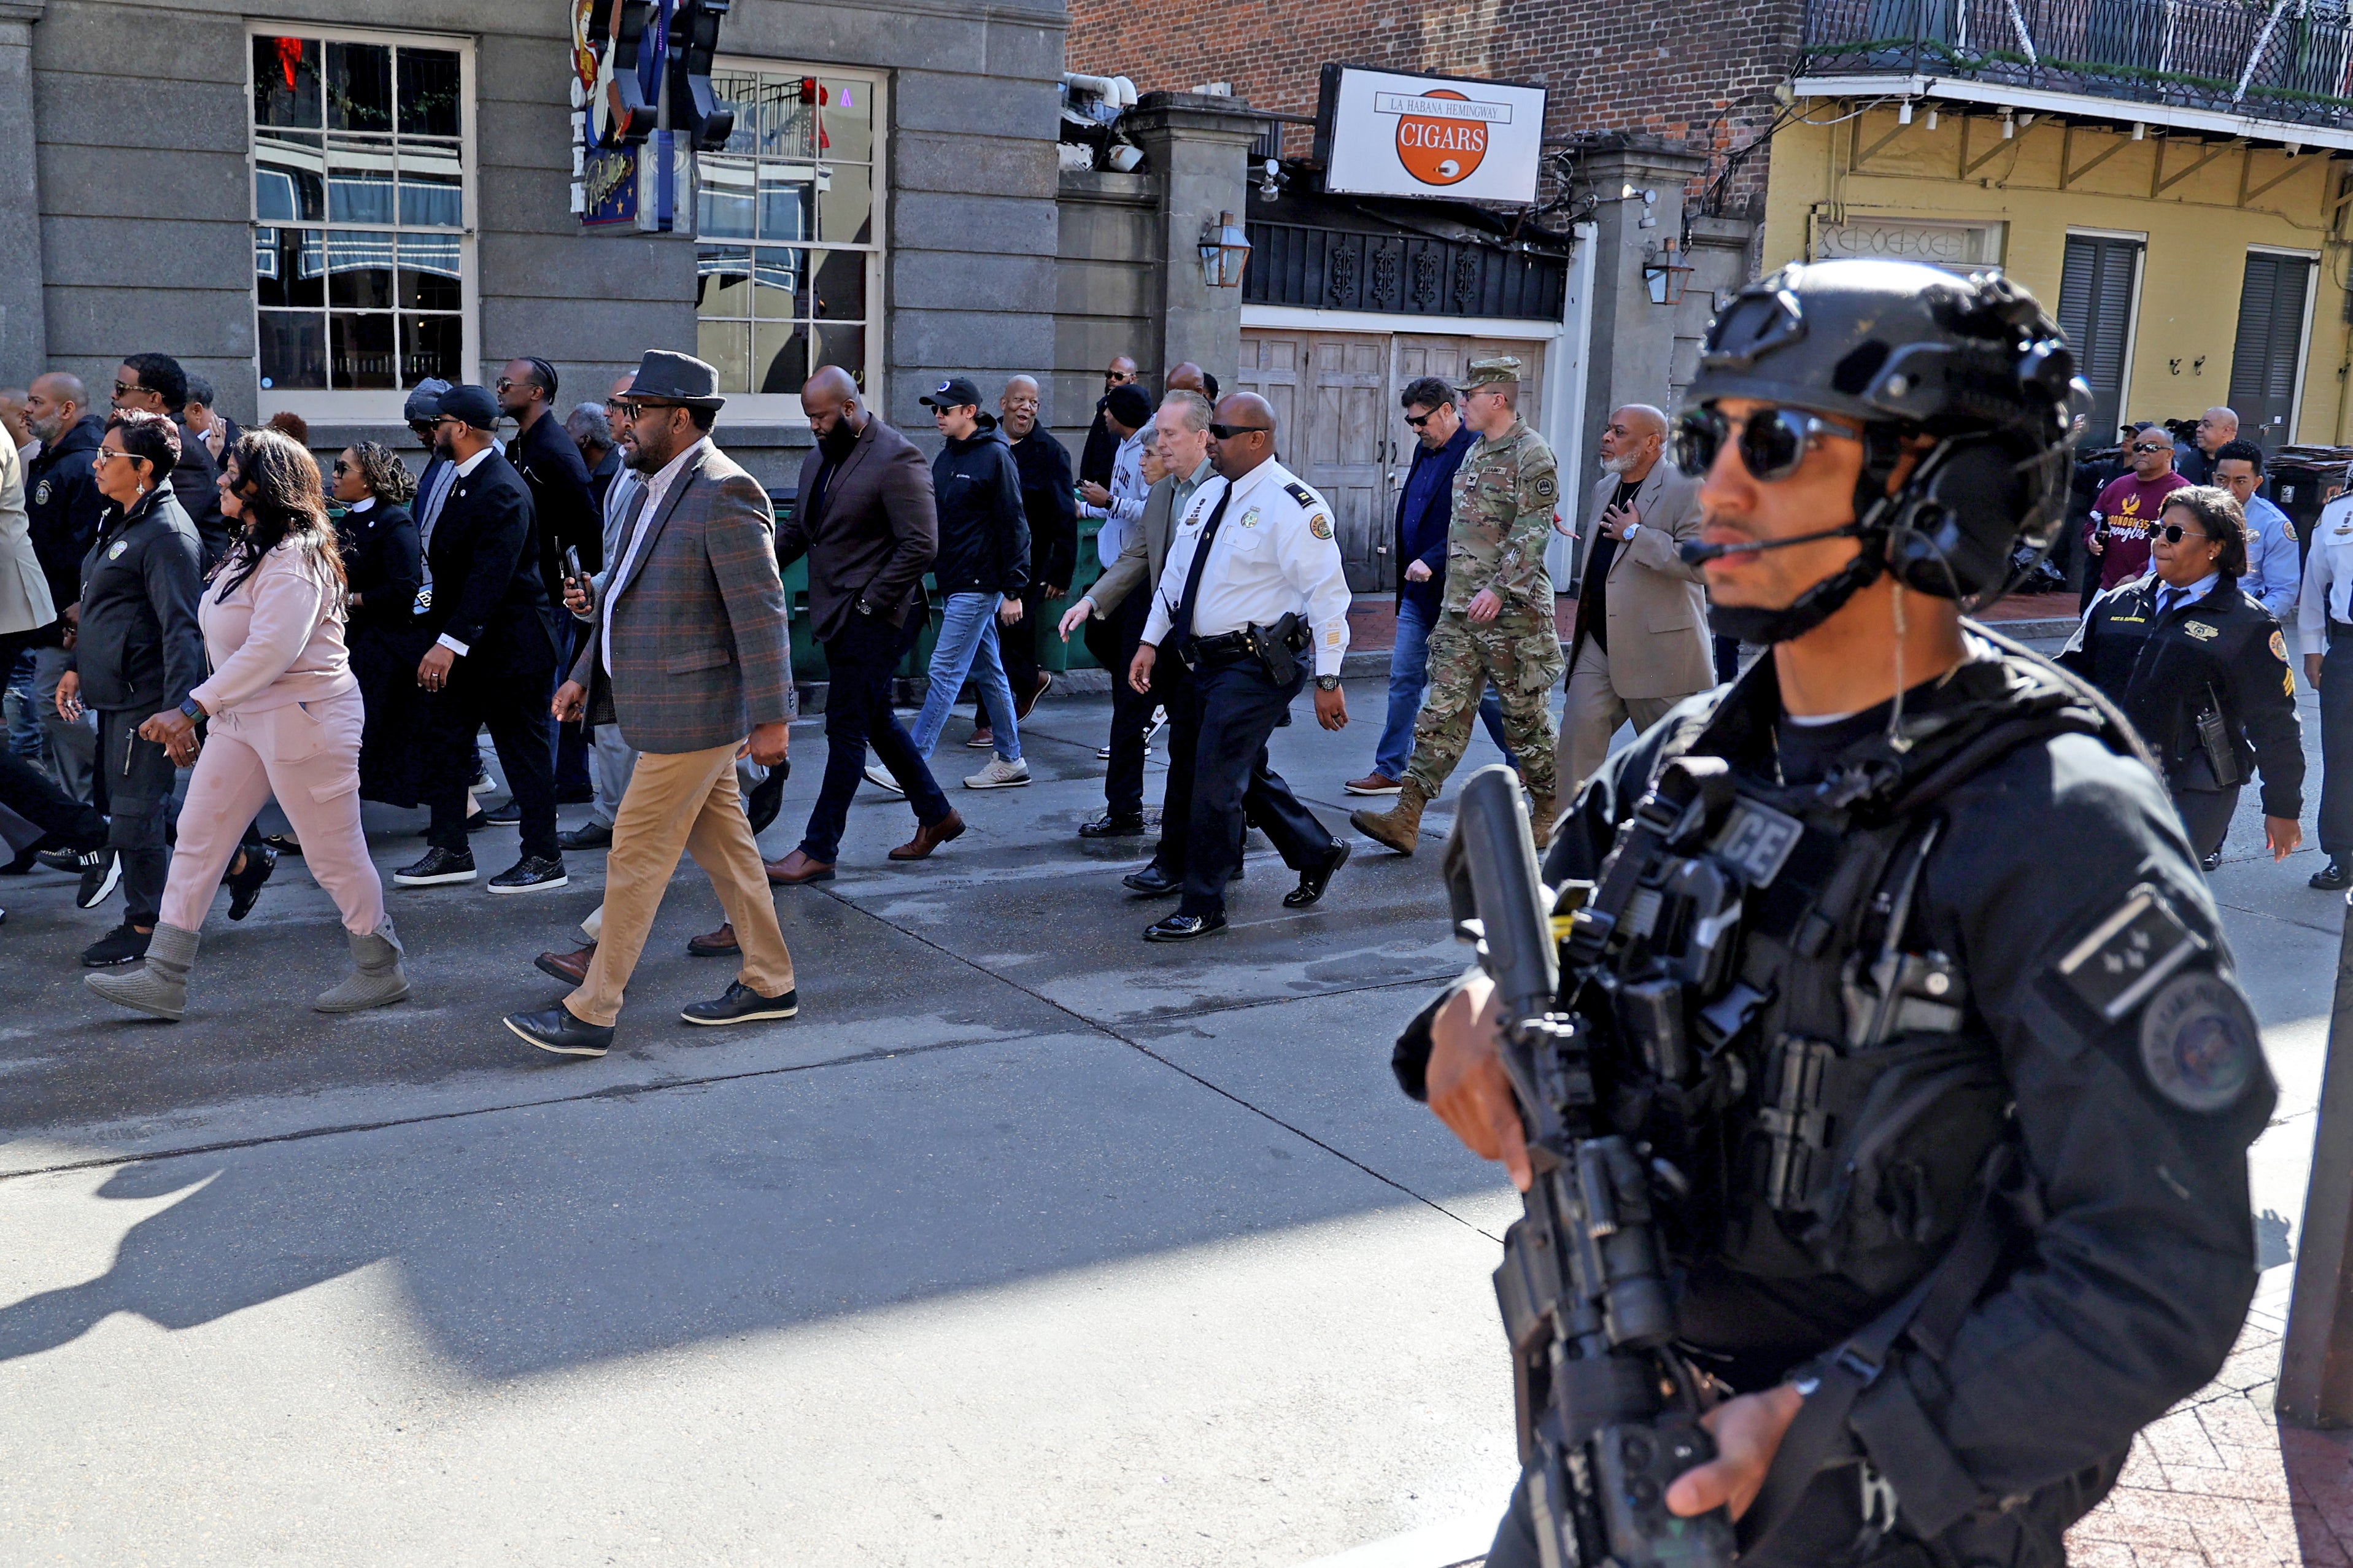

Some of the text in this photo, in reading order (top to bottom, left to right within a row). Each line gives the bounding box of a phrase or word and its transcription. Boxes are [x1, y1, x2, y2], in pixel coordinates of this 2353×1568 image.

[1391, 98, 1498, 119] LA HABANA HEMINGWAY
[1401, 123, 1484, 152] CIGARS
[2138, 519, 2150, 530] 35
[1709, 808, 1788, 874] ICE
[78, 851, 99, 866] AITI
